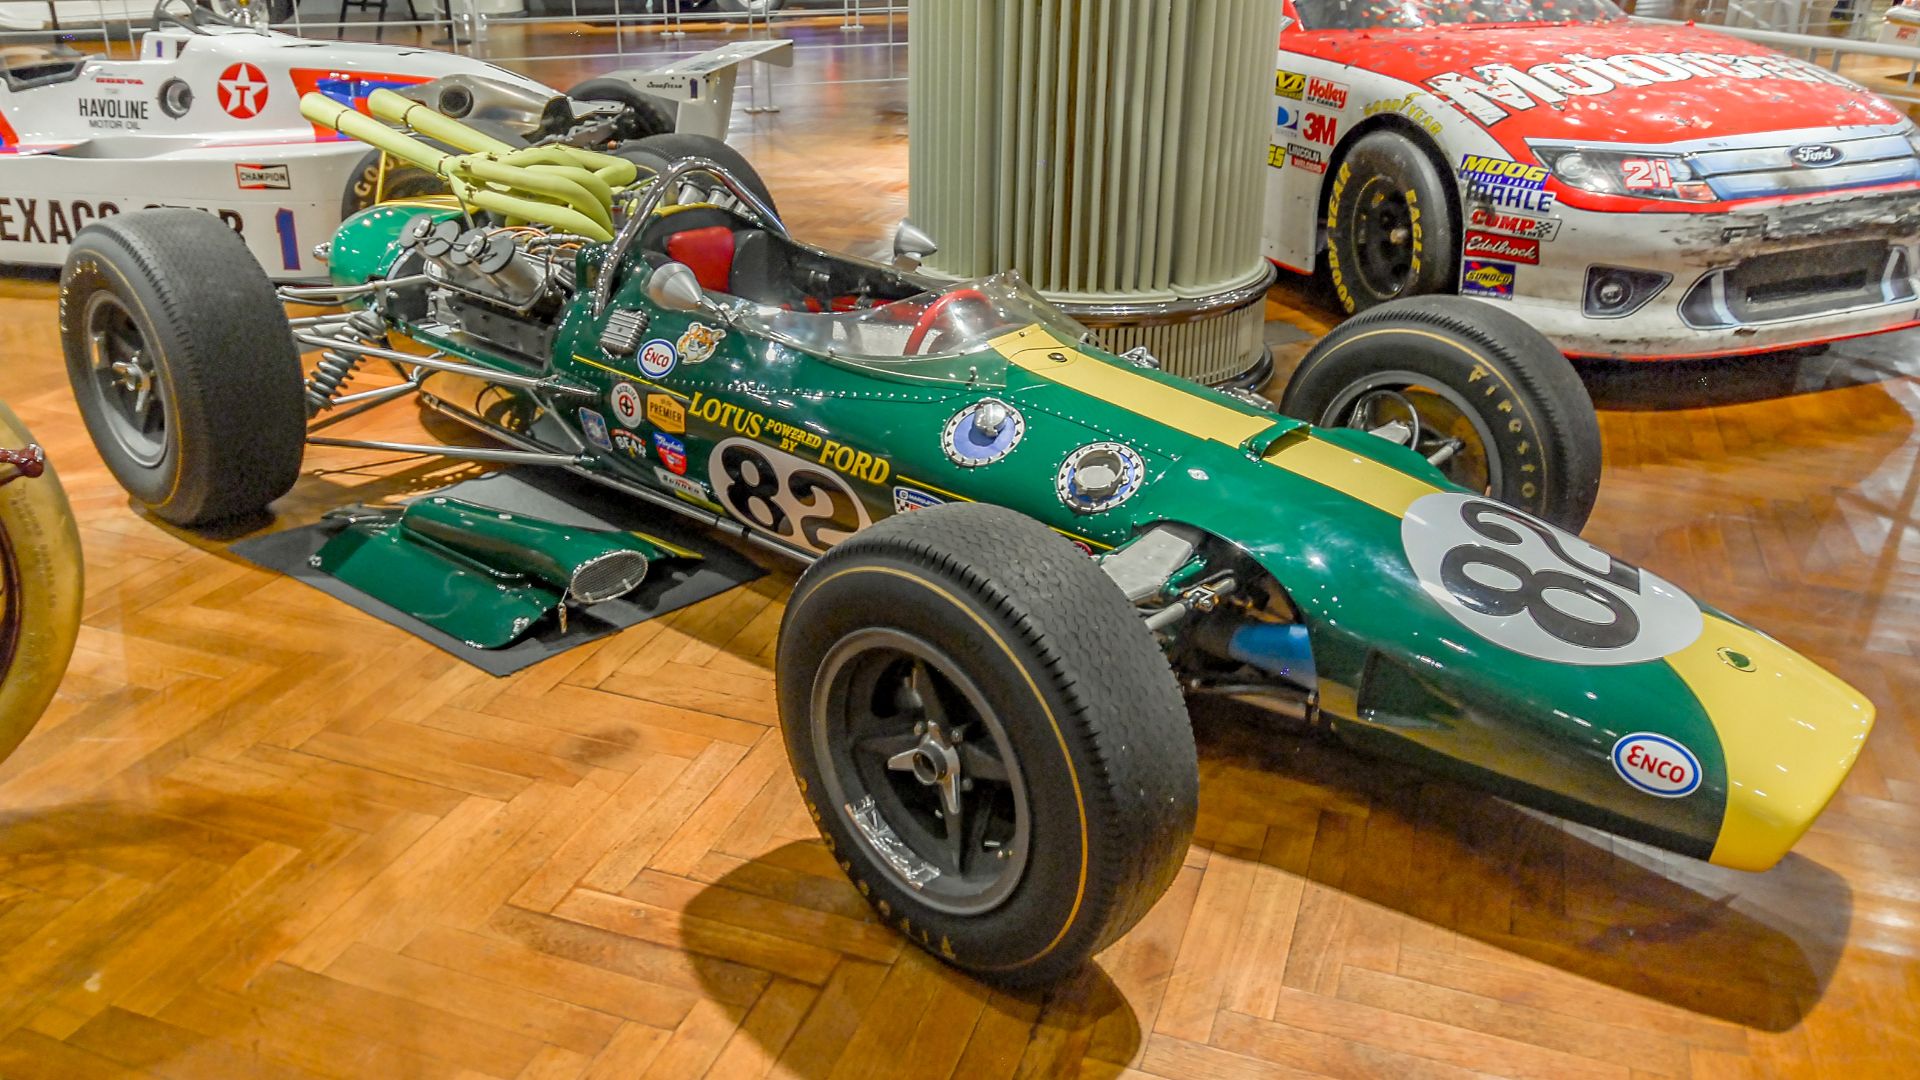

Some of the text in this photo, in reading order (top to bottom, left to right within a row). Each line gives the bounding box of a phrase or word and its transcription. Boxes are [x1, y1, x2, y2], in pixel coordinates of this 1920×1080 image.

[690, 78, 698, 99] 1
[1308, 78, 1347, 109] Holley
[79, 97, 149, 120] HAVOLINE
[89, 119, 142, 130] MOTOR OIL
[1302, 112, 1338, 146] 3M
[1796, 146, 1836, 163] Ford
[239, 171, 286, 182] CHAMPION
[1461, 156, 1550, 182] MOOG
[1622, 159, 1672, 189] 21
[0, 197, 120, 244] EXAC
[1472, 209, 1536, 232] COMP
[275, 207, 301, 271] 1
[1466, 236, 1536, 259] Edelbrock
[1466, 271, 1513, 285] SUNOCO
[644, 347, 670, 369] ENCO
[650, 402, 683, 422] PREMIER
[688, 391, 764, 438] LOTUS
[765, 418, 822, 449] POWERED
[614, 435, 647, 459] BEAR
[779, 437, 798, 453] BY
[819, 439, 890, 485] FORD
[721, 443, 860, 549] 82
[1440, 499, 1641, 649] 82
[1626, 745, 1686, 784] ENCO
